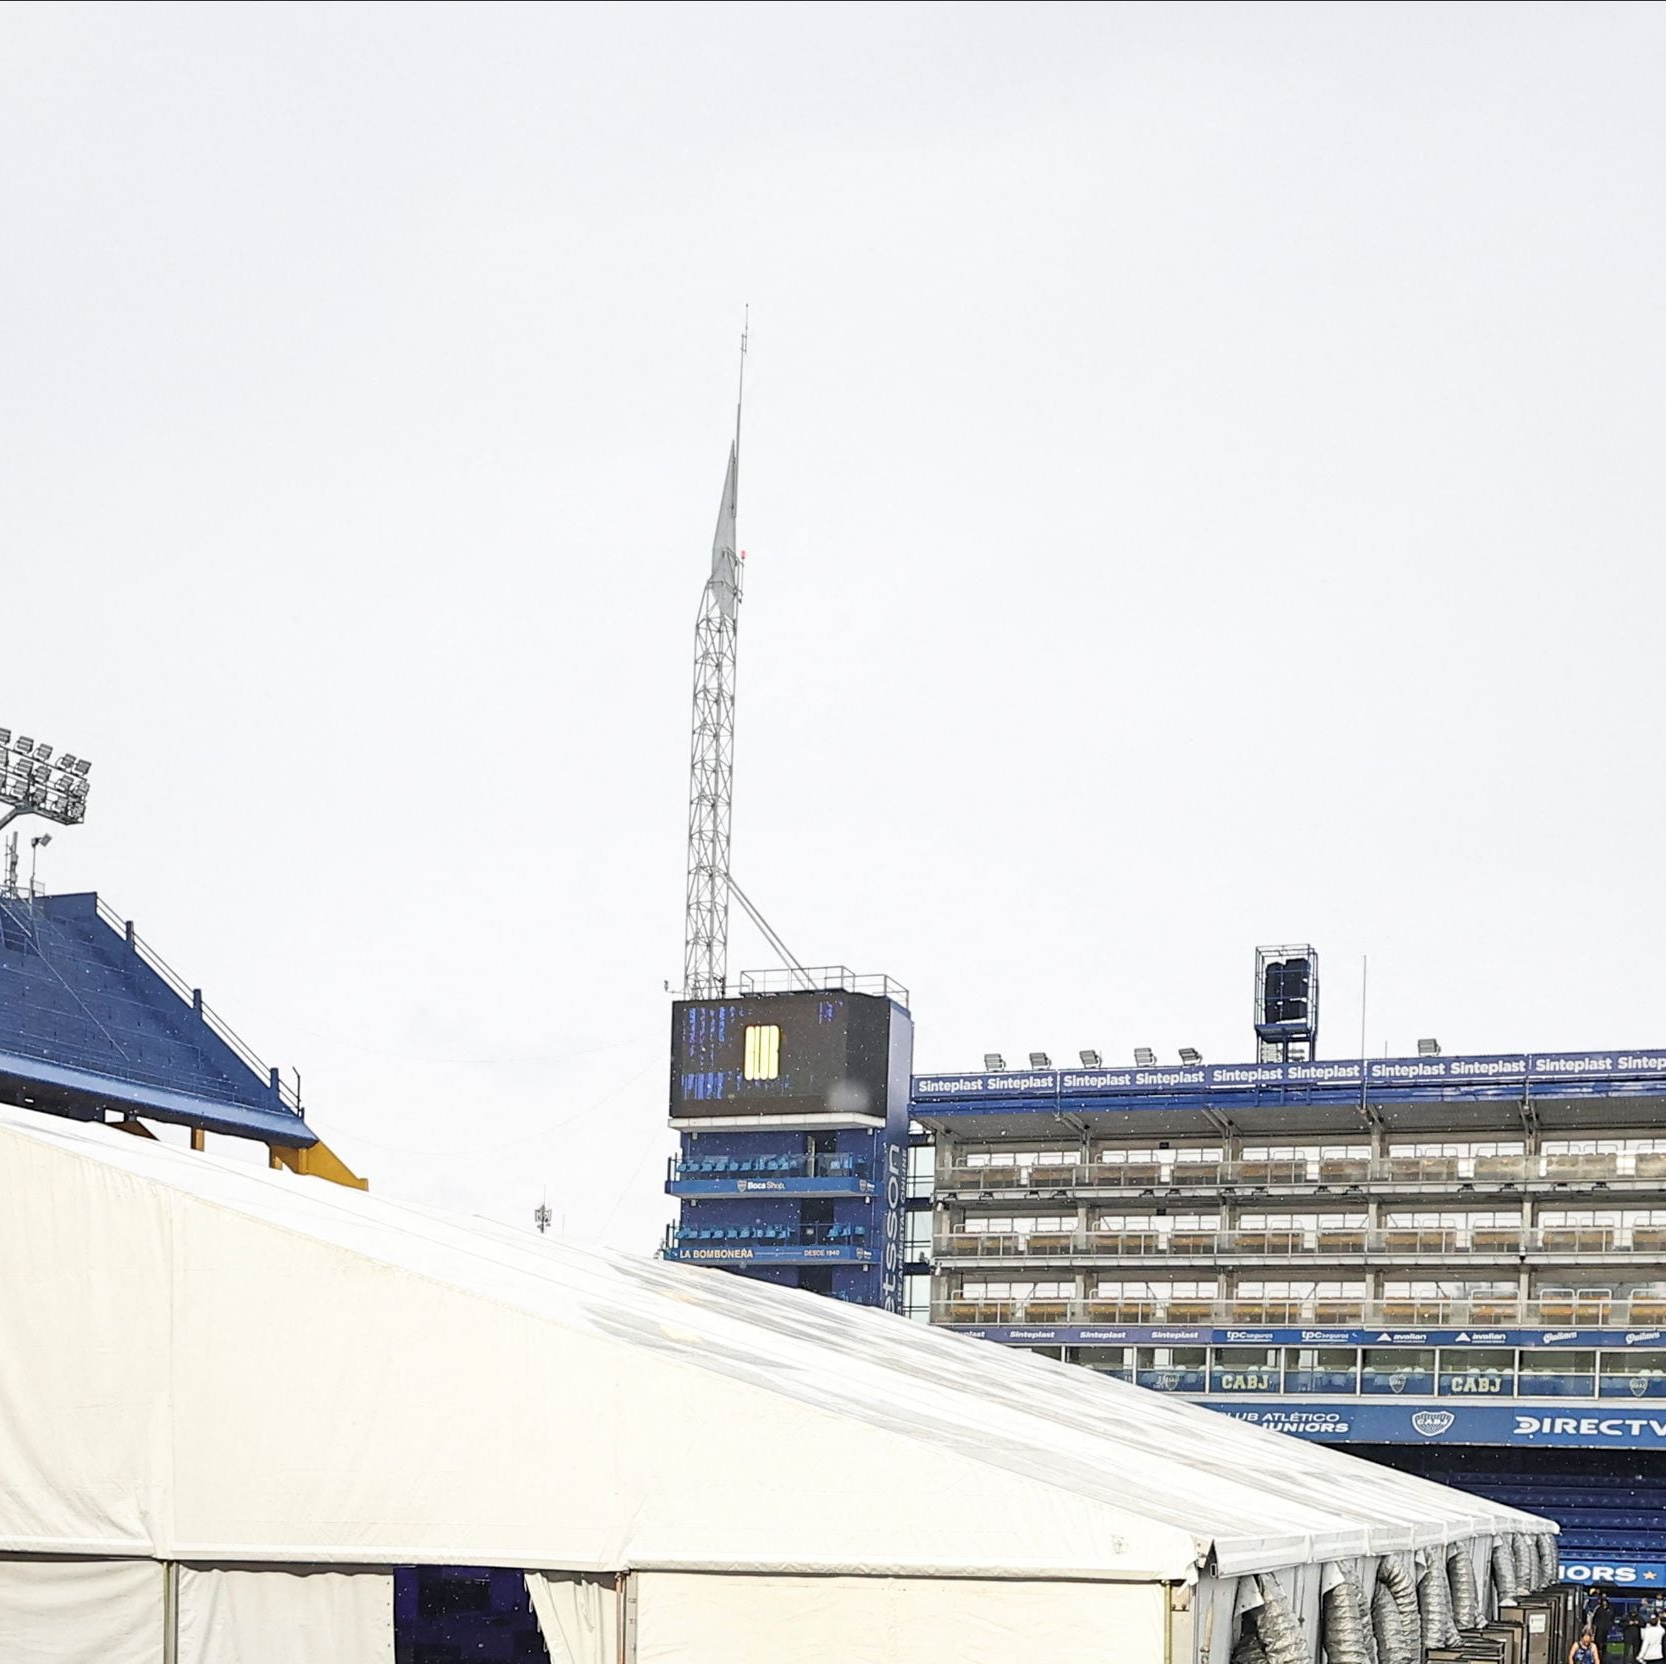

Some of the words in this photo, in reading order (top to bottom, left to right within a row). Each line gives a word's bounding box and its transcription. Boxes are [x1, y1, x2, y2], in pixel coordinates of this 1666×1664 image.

[919, 1079, 982, 1093] Sinteplast
[987, 1076, 1053, 1091] Sinteplast
[1063, 1074, 1131, 1089] Sinteplast
[1136, 1071, 1205, 1086] Sinteplast
[1213, 1068, 1283, 1083] Sinteplast
[1288, 1065, 1360, 1081] Sinteplast
[1372, 1062, 1445, 1078] Sinteplast
[1450, 1060, 1526, 1075] Sinteplast
[1536, 1056, 1612, 1073] Sinteplast
[883, 1144, 900, 1313] etsson
[680, 1250, 691, 1259] LA
[693, 1249, 753, 1259] BOMBONERA
[1010, 1331, 1055, 1339] Sinteplast
[1080, 1331, 1126, 1339] Sinteplast
[1151, 1331, 1199, 1340] Sinteplast
[1221, 1375, 1270, 1390] CABJ
[1451, 1377, 1501, 1392] CABJ
[1228, 1412, 1259, 1421] LUB
[1262, 1411, 1340, 1422] ATLÉTICO
